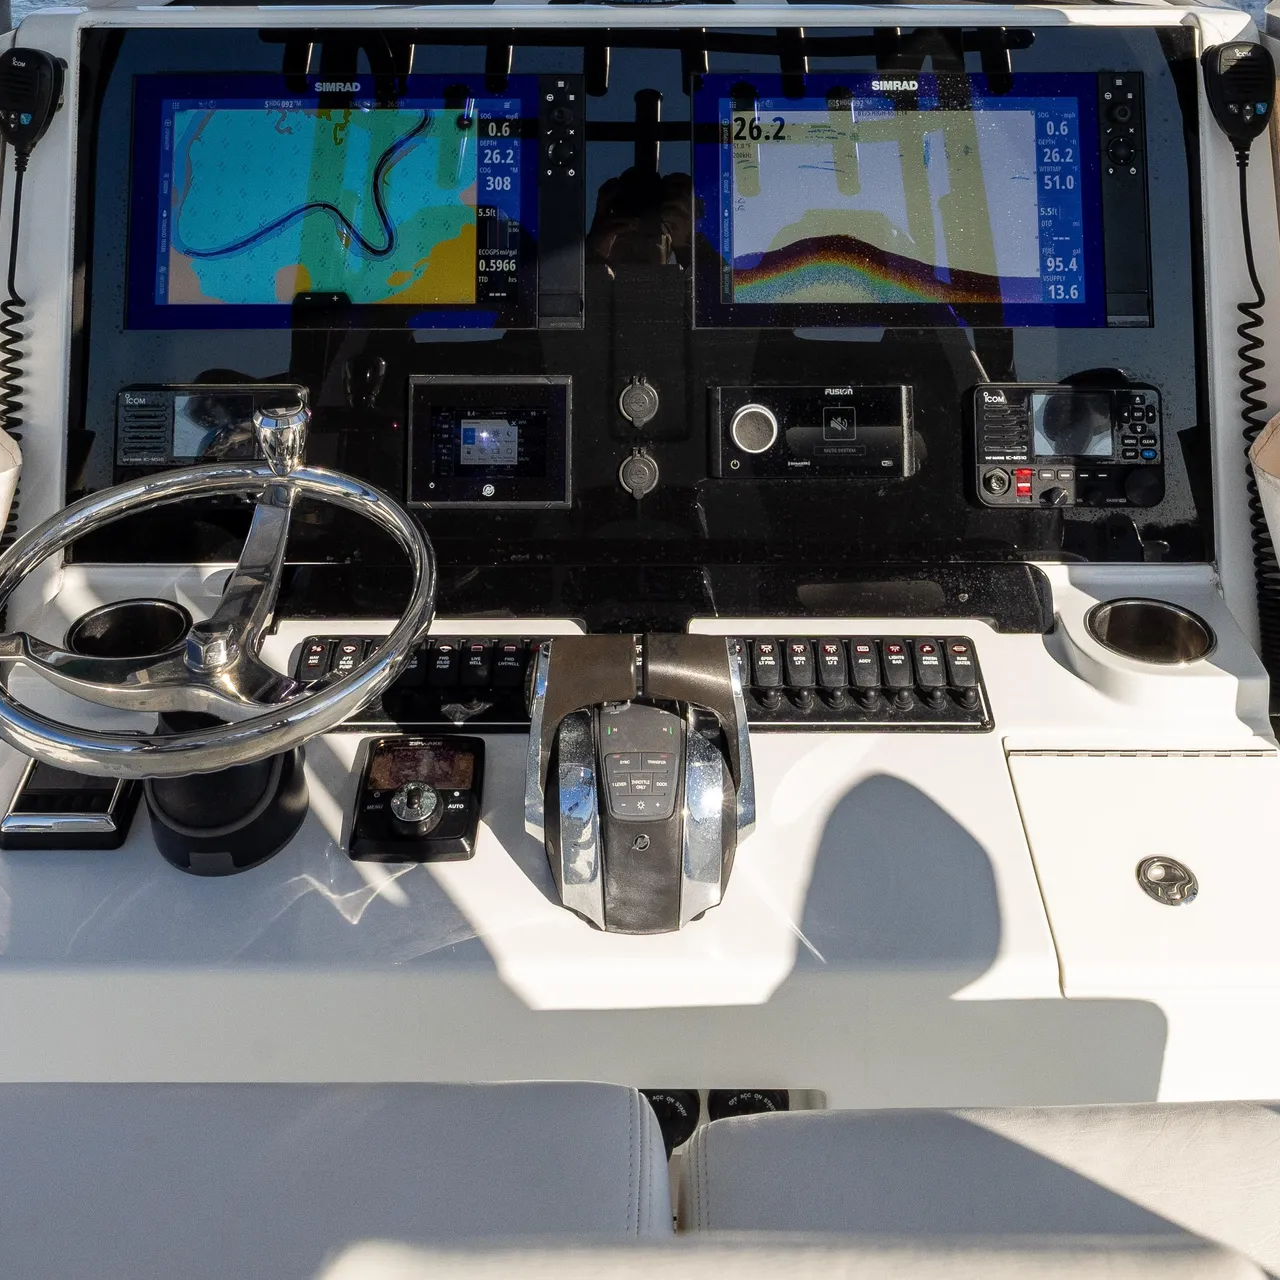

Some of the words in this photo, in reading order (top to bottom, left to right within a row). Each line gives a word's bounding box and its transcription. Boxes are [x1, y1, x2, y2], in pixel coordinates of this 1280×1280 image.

[314, 82, 361, 92] SIMRAD
[871, 81, 918, 91] SIMRAD
[488, 122, 511, 136] 0.6
[733, 118, 786, 141] 26.2
[1046, 121, 1069, 135] 0.6
[484, 149, 515, 163] 26.2
[1043, 148, 1073, 162] 26.2
[486, 176, 511, 190] 308
[1044, 175, 1074, 189] 51.0
[479, 259, 517, 273] 0.5966
[1047, 257, 1078, 272] 95.4
[1048, 285, 1079, 300] 13.6
[666, 1096, 675, 1104] ON
[674, 1101, 687, 1117] START
